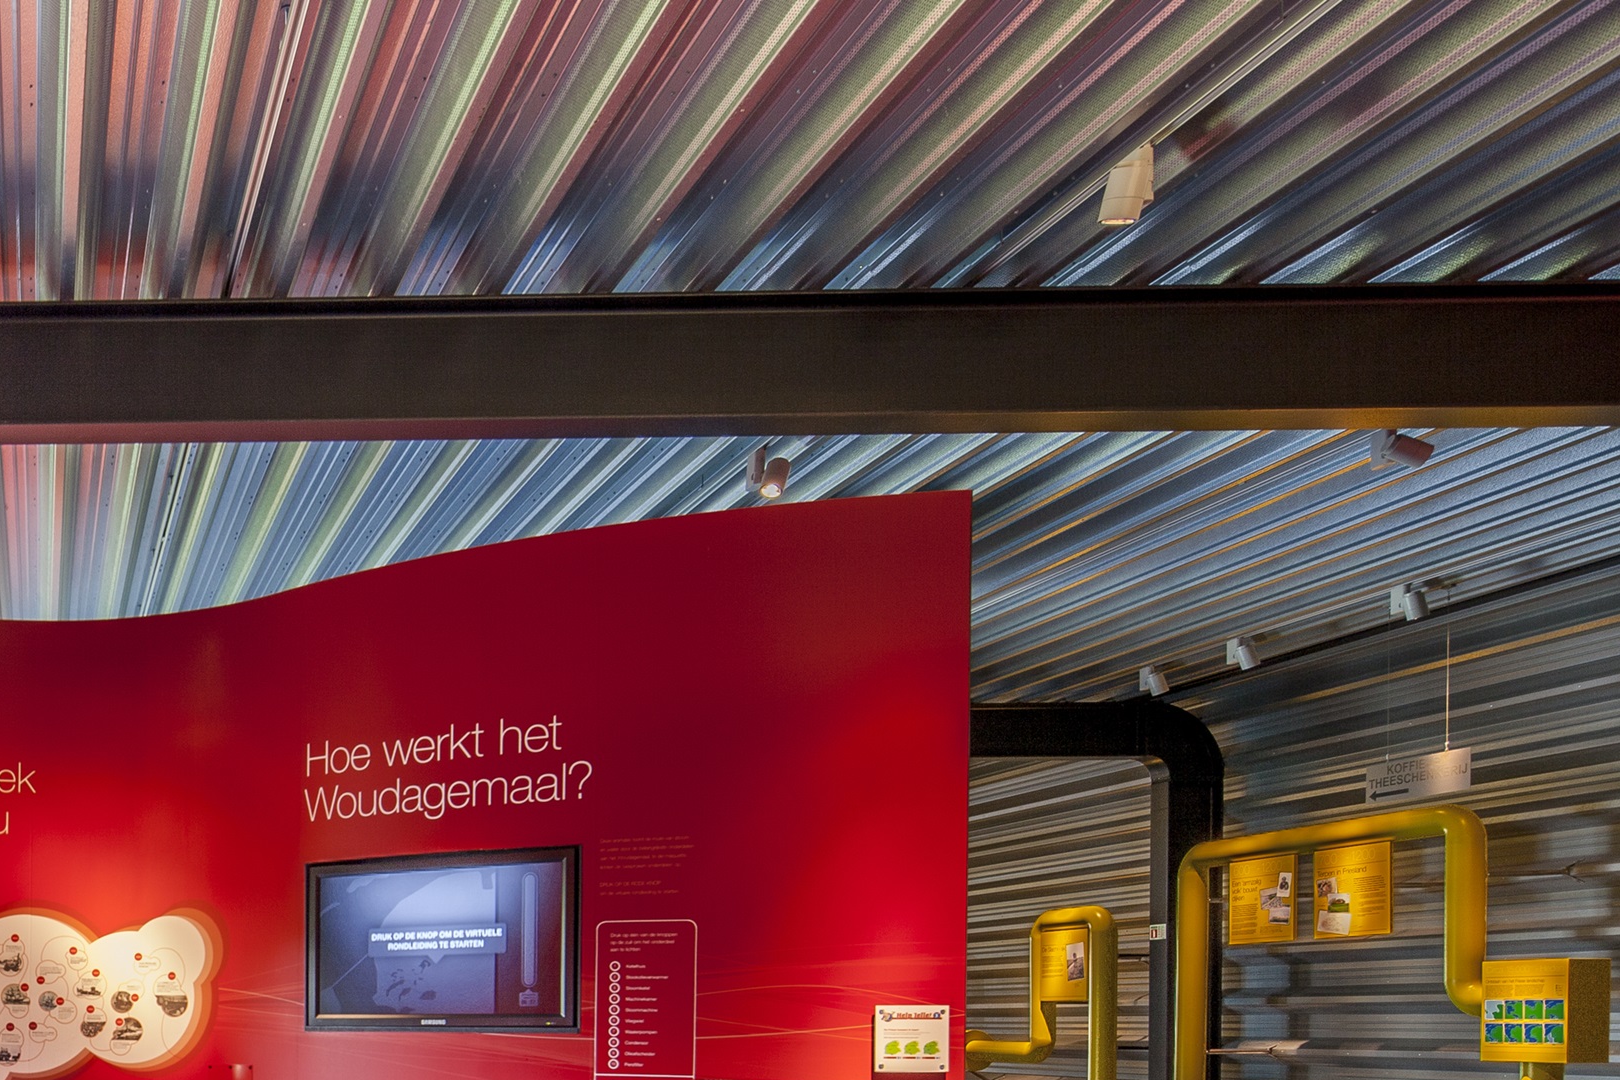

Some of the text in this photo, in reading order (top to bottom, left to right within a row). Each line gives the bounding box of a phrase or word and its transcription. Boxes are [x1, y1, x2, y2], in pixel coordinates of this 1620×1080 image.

[306, 714, 562, 777] Hoe werkt het
[1369, 763, 1468, 789] THEESCHENKERIJ
[1386, 760, 1425, 775] KOFFIE
[304, 760, 593, 822] Woudagemaal?
[371, 928, 502, 941] DRUK OP DE KNOP OM DE VIRTUELE
[387, 940, 484, 950] RONDLEIDING TE STARTEN
